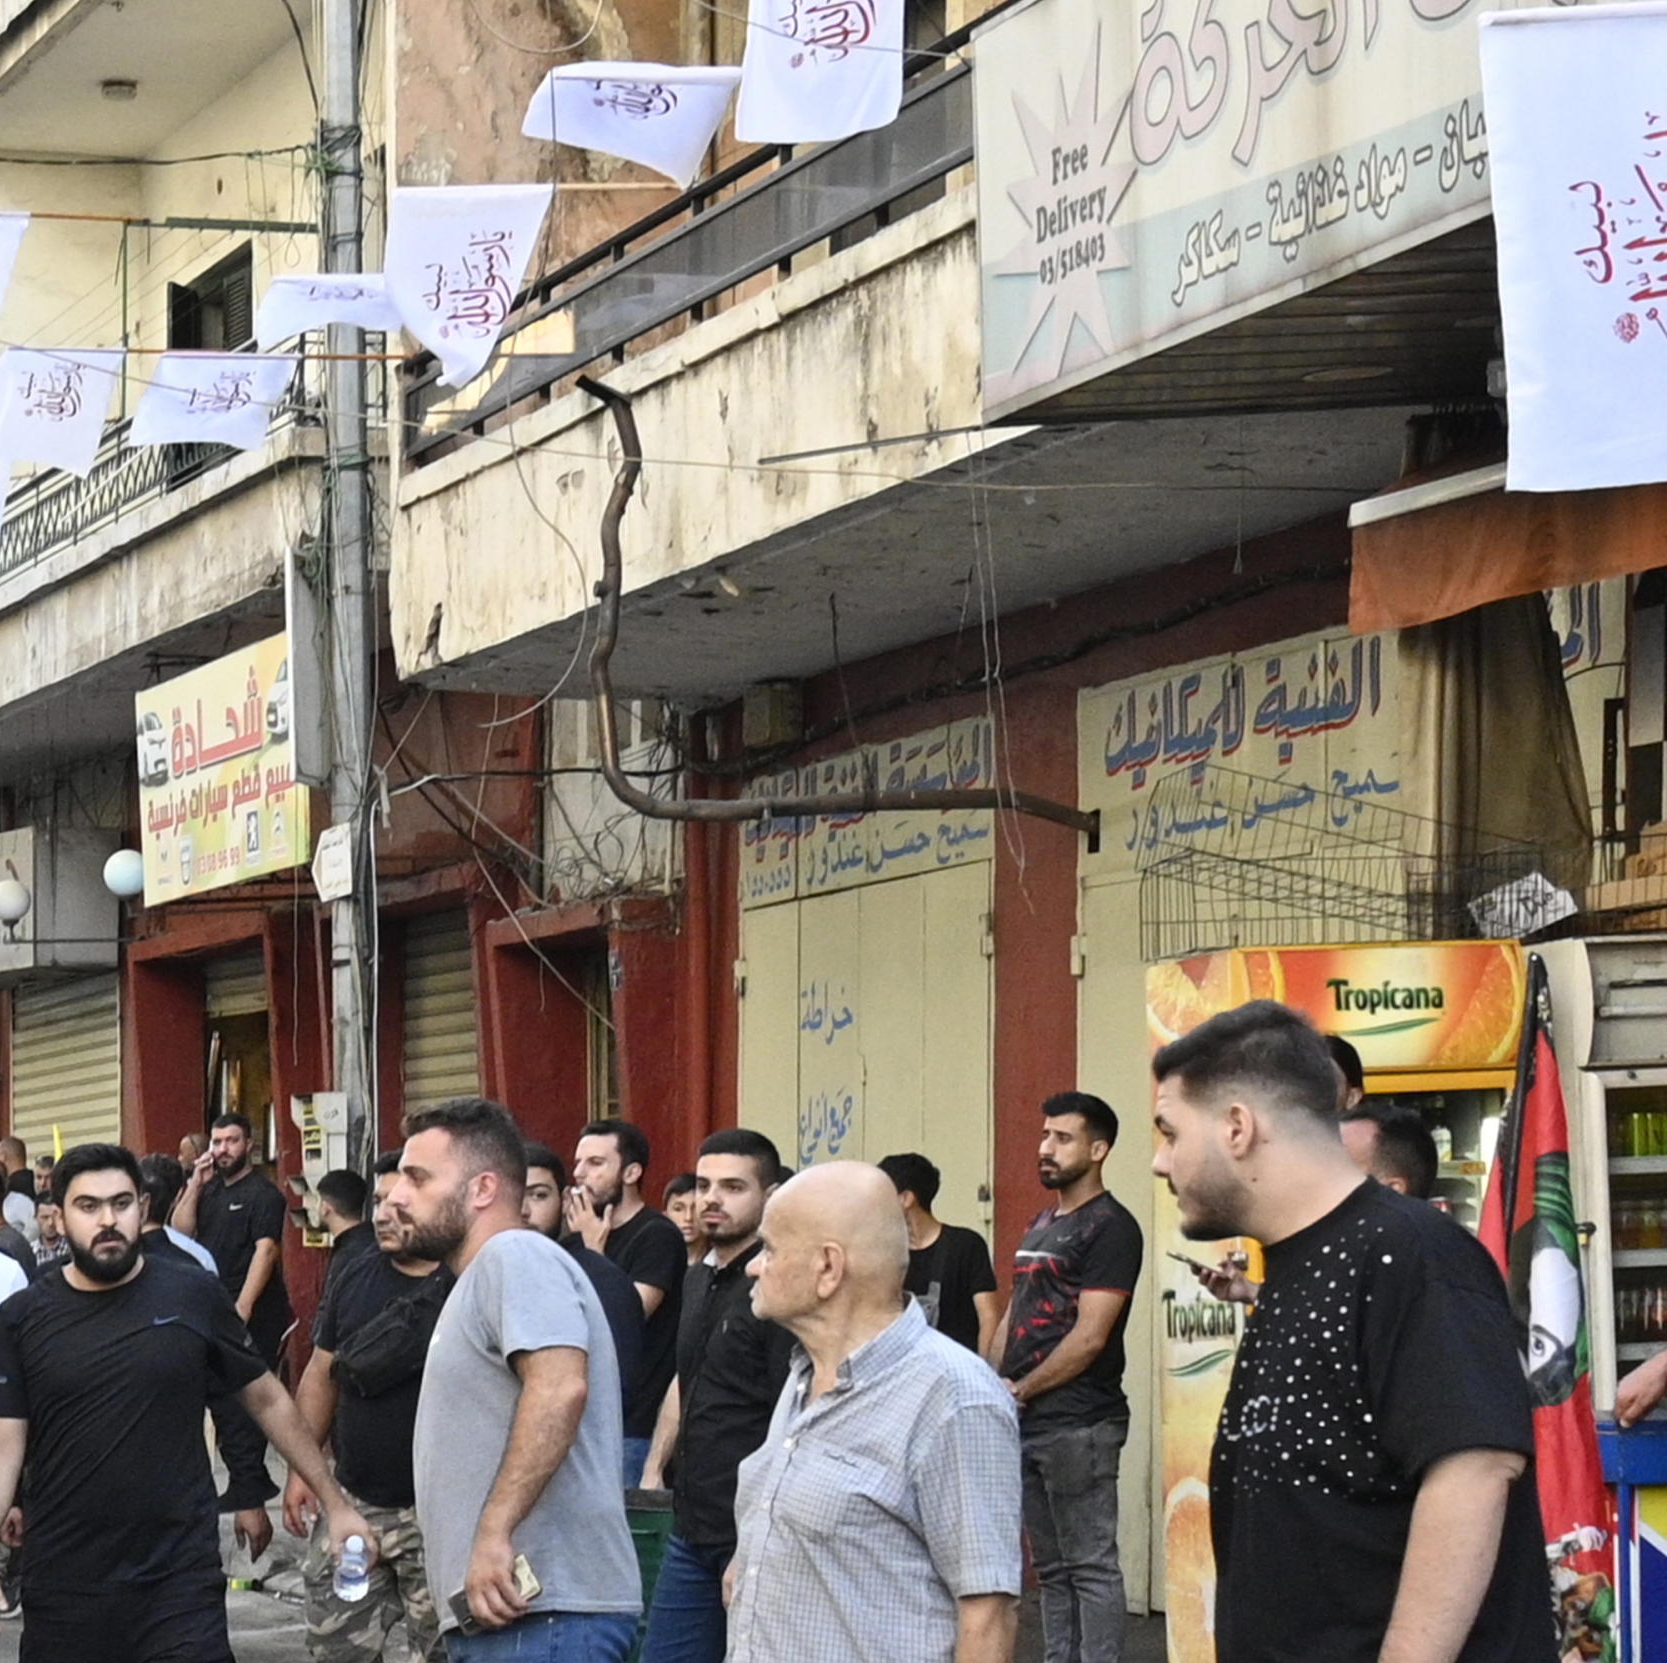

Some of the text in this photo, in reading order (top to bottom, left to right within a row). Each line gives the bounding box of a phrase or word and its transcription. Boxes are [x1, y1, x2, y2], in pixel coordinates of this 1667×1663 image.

[1051, 142, 1089, 186] Free
[1354, 142, 1408, 219] مواد
[1035, 186, 1108, 245] Delivery
[1038, 242, 1107, 287] 03/518403
[1171, 209, 1242, 307] سكاكر
[1326, 978, 1445, 1015] Tropicana
[1161, 1288, 1237, 1344] Tropicana
